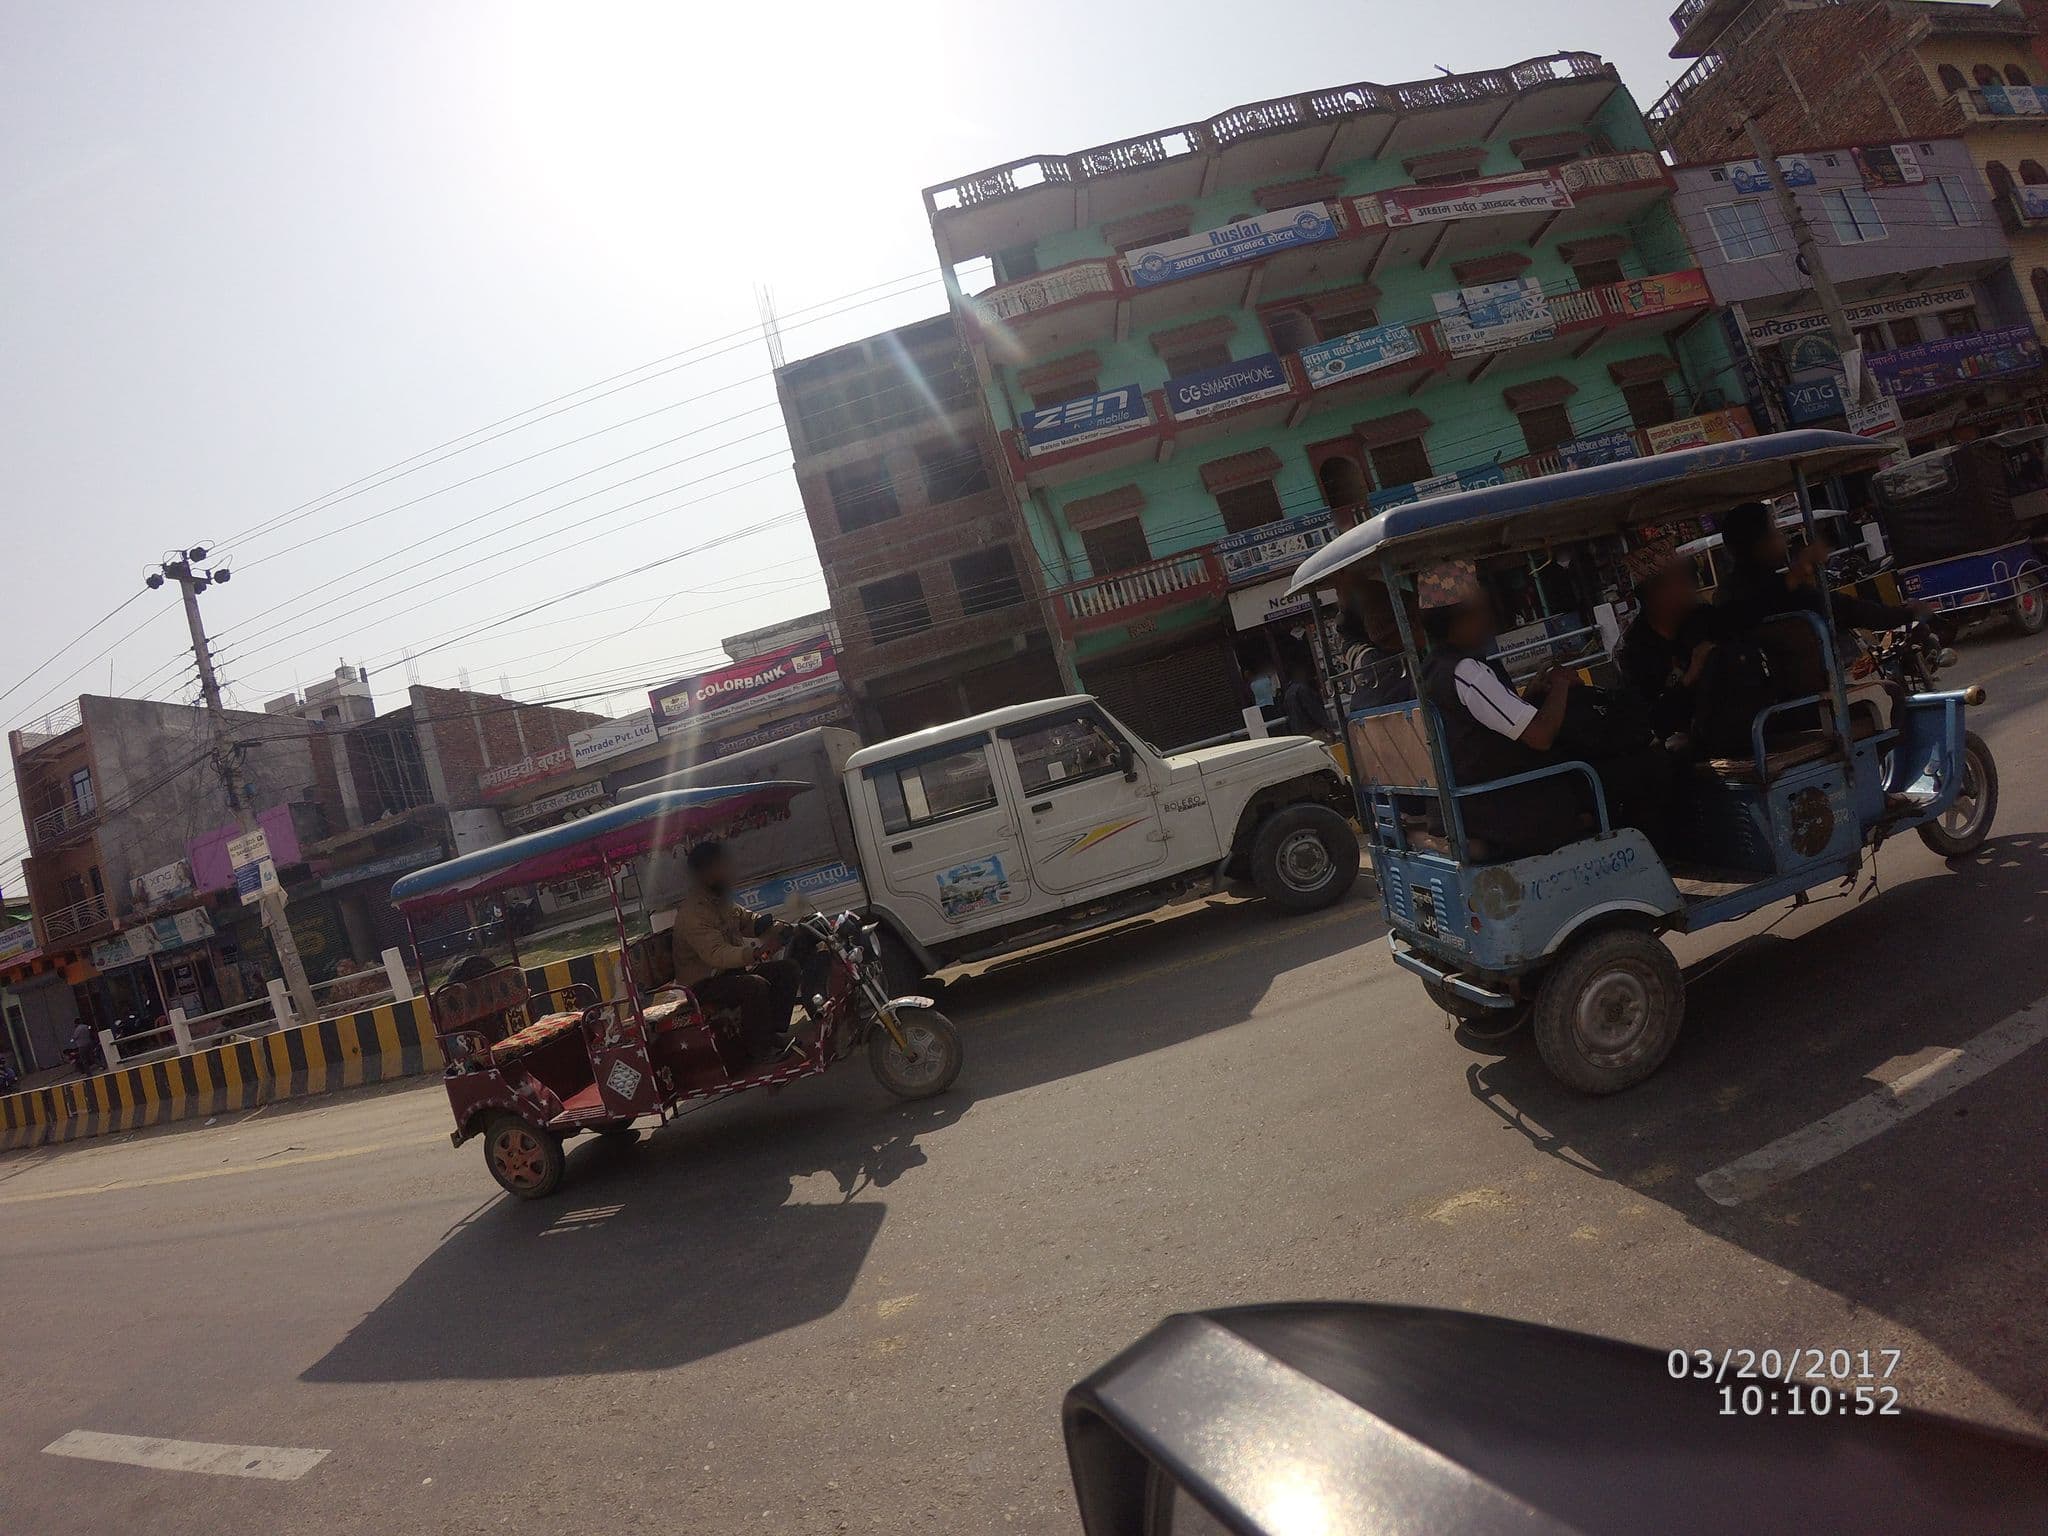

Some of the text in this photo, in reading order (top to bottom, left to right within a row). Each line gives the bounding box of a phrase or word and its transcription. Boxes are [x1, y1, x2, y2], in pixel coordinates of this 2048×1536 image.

[1208, 223, 1262, 246] Ruslan
[1449, 330, 1485, 344] STEP UP
[1751, 316, 1798, 339] गरिक
[1178, 366, 1275, 403] CG SMARTPHONE
[1096, 410, 1130, 427] mobile
[695, 664, 786, 701] COLORBANK
[575, 738, 615, 758] Amtrade
[615, 733, 634, 745] Pvt.
[634, 724, 653, 737] Ltd.
[1164, 795, 1201, 812] BOLERO
